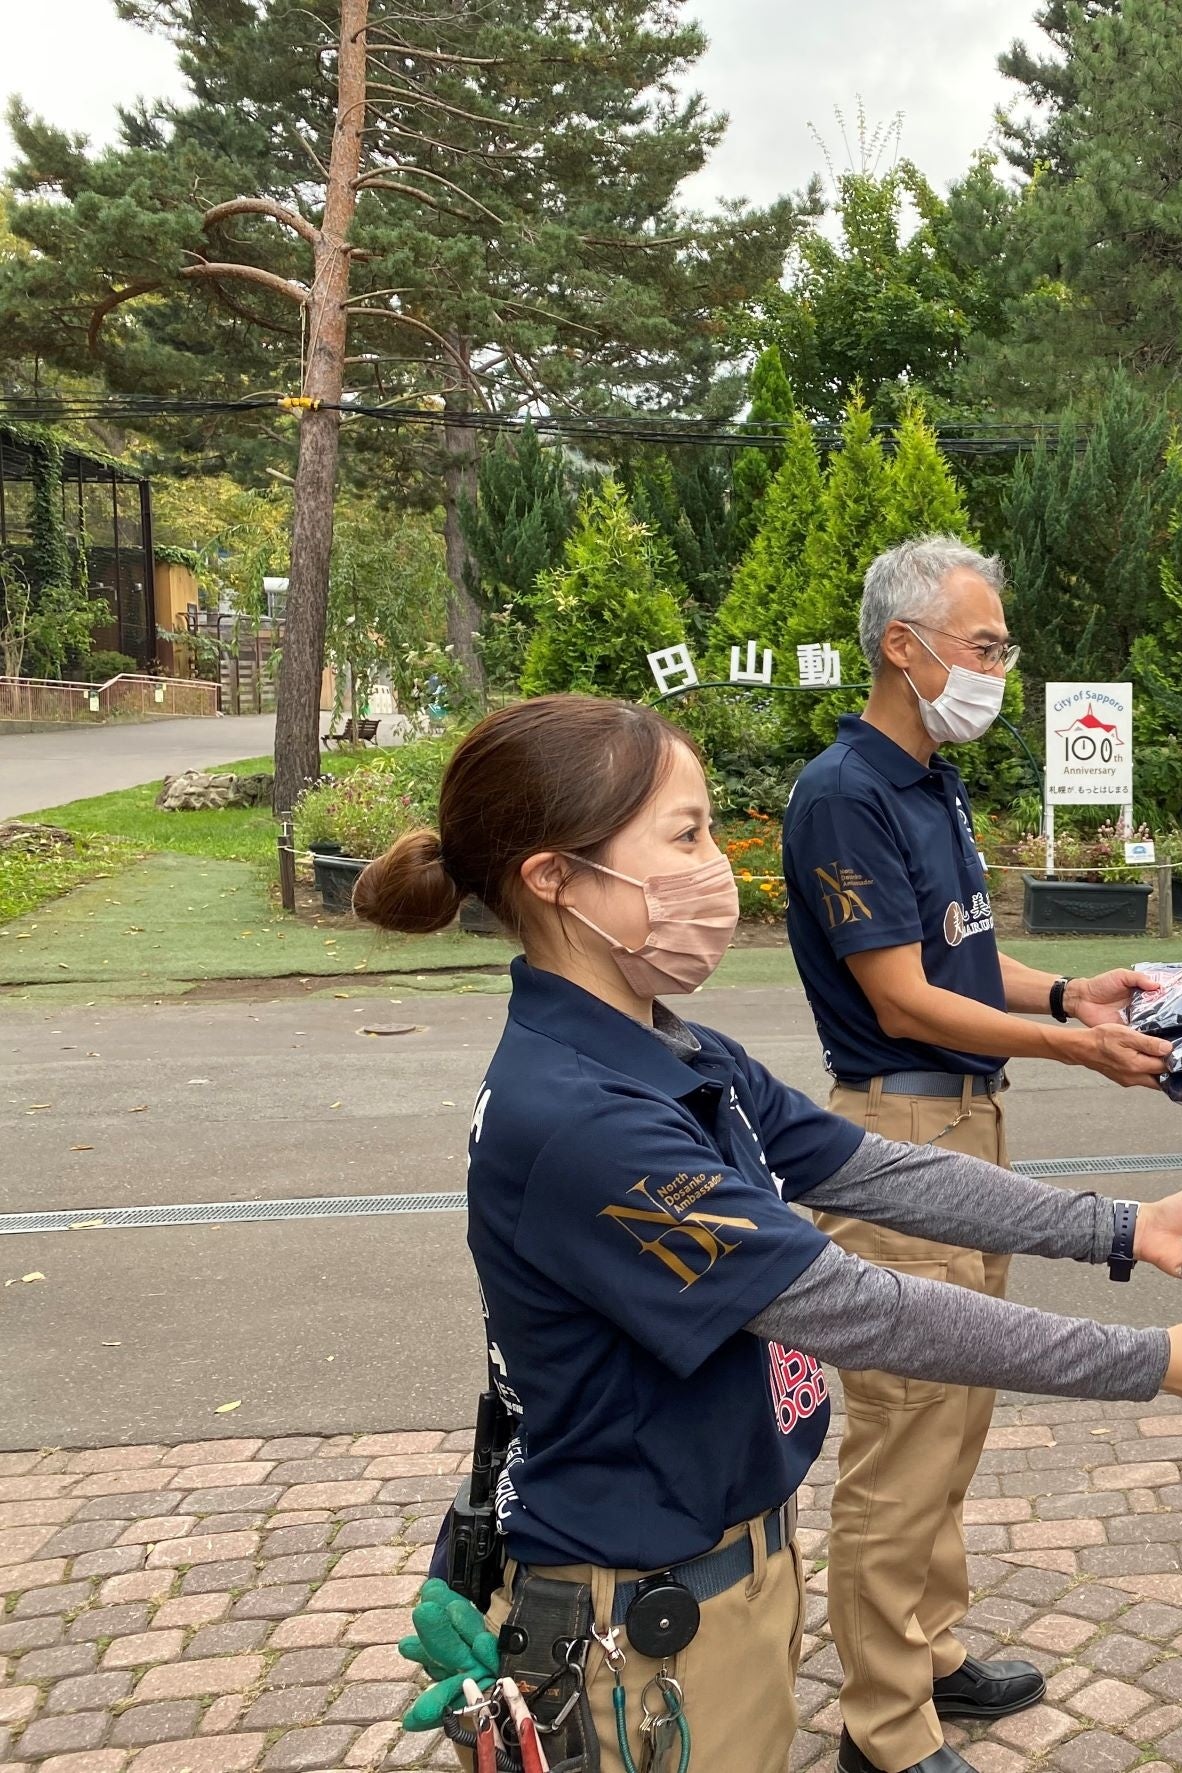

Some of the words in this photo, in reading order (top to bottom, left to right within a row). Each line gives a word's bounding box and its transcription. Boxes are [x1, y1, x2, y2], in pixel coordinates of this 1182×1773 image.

[647, 640, 842, 695] 円山動
[1053, 695, 1073, 712] City
[1073, 690, 1083, 701] of
[1085, 690, 1124, 712] Sapporo
[1064, 766, 1116, 777] Anniversary
[656, 1172, 688, 1198] North
[664, 1173, 706, 1207] Dosanko
[673, 1173, 724, 1214] Ambassador
